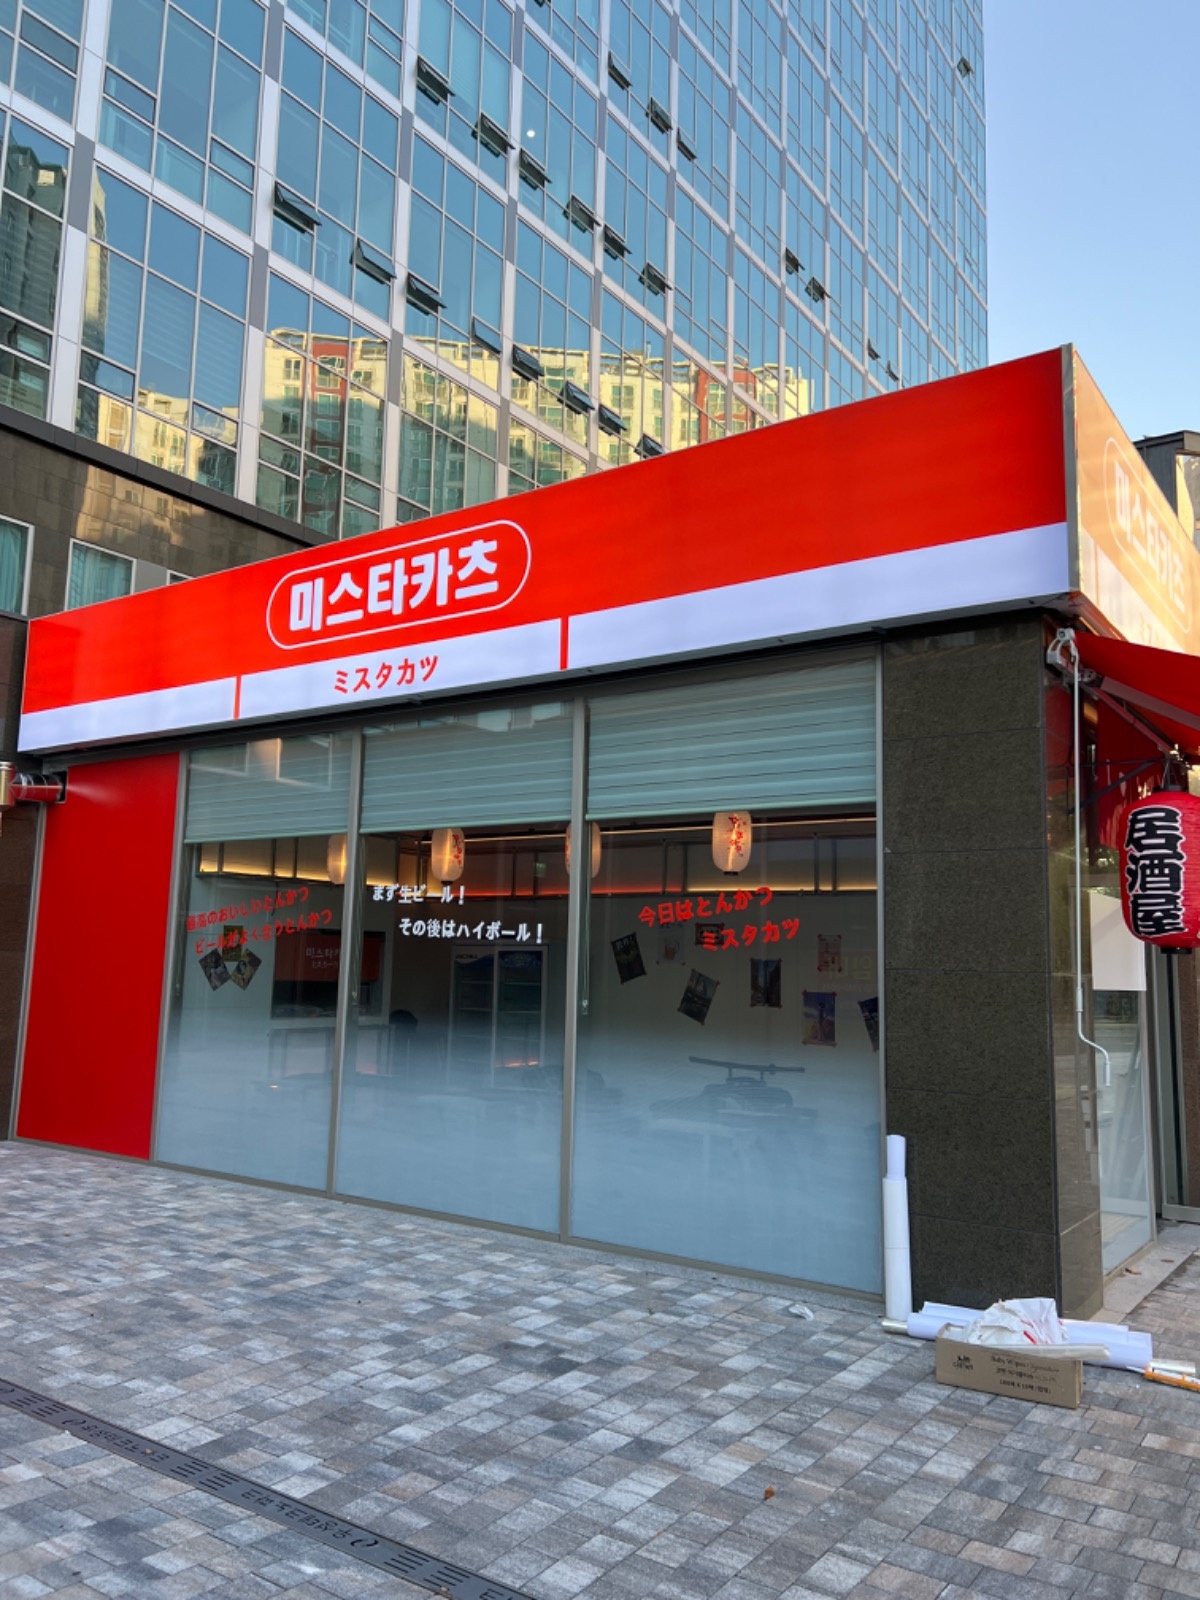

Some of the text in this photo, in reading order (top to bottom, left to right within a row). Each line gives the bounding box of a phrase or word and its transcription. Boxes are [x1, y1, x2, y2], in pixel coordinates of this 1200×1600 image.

[1115, 460, 1185, 614] 미스타카츠
[289, 539, 499, 632] 미스타카츠
[333, 655, 439, 694] ミスタカツ
[1124, 805, 1188, 937] 居酒屋
[638, 886, 773, 927] 今日はとんかつ
[398, 918, 544, 943] その後はハイボール！
[703, 918, 800, 951] ミスタカツ
